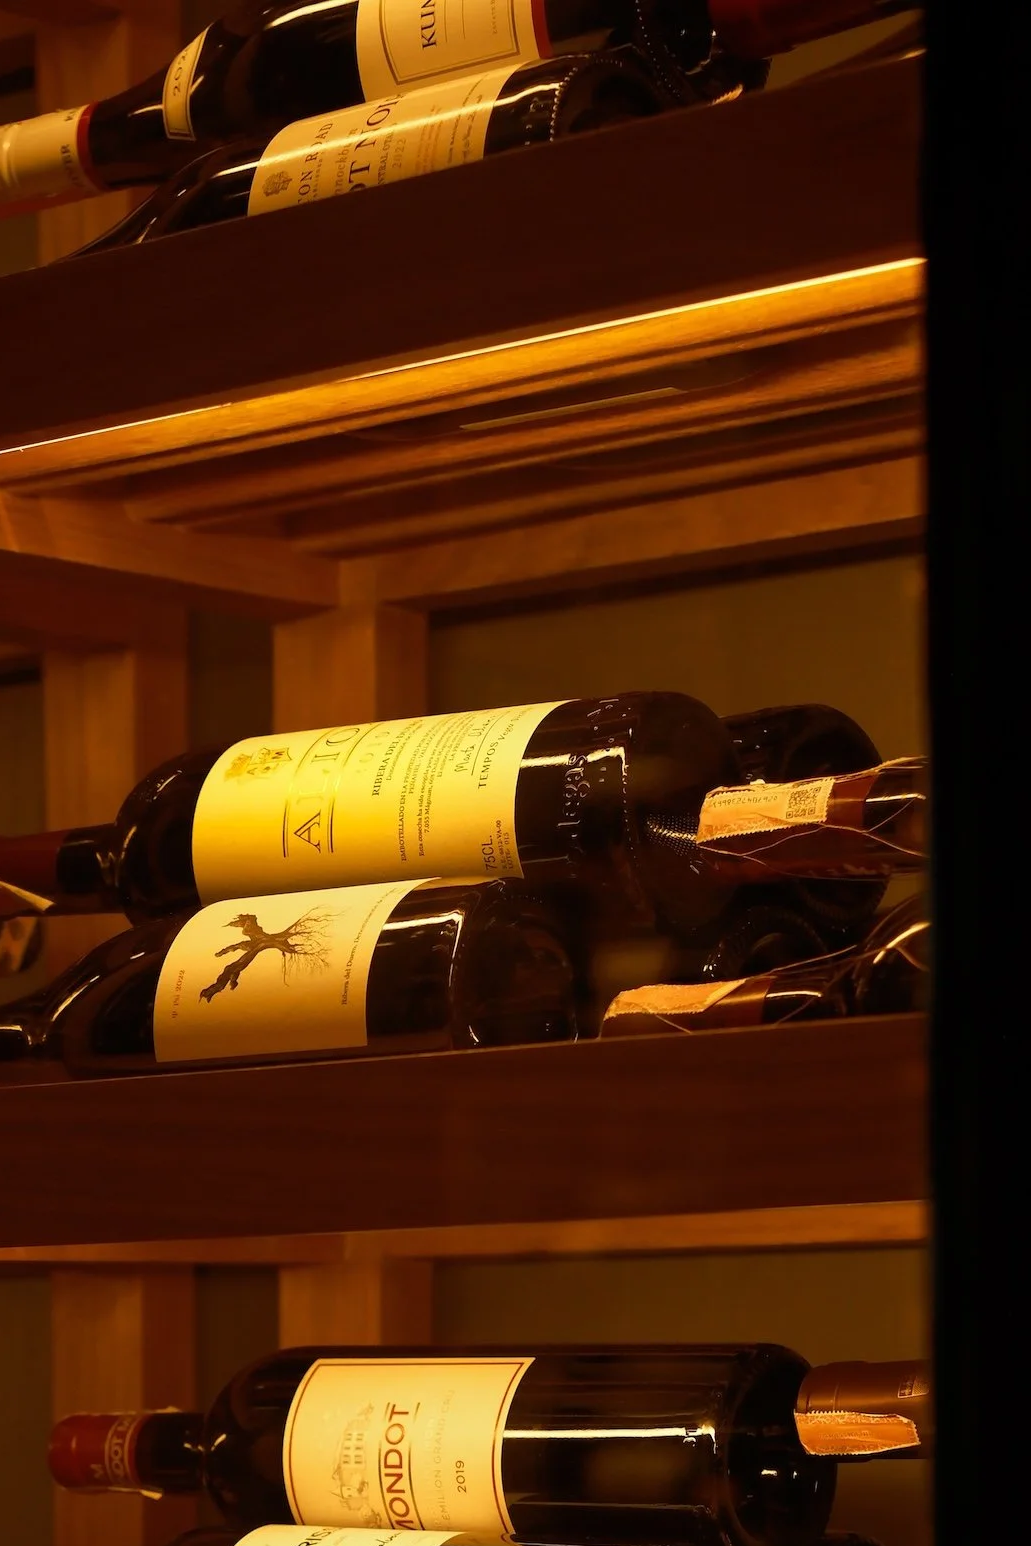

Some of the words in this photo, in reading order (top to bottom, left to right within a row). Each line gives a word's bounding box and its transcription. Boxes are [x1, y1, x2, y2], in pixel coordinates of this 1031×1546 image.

[372, 757, 390, 797] RIBERA
[477, 740, 500, 790] TEMPOS
[398, 804, 407, 862] EMBOTELLADO
[481, 833, 498, 872] 75CL.
[174, 968, 186, 992] 2022
[343, 967, 352, 981] del
[341, 980, 349, 1006] Ribera
[455, 1460, 467, 1494] 2019
